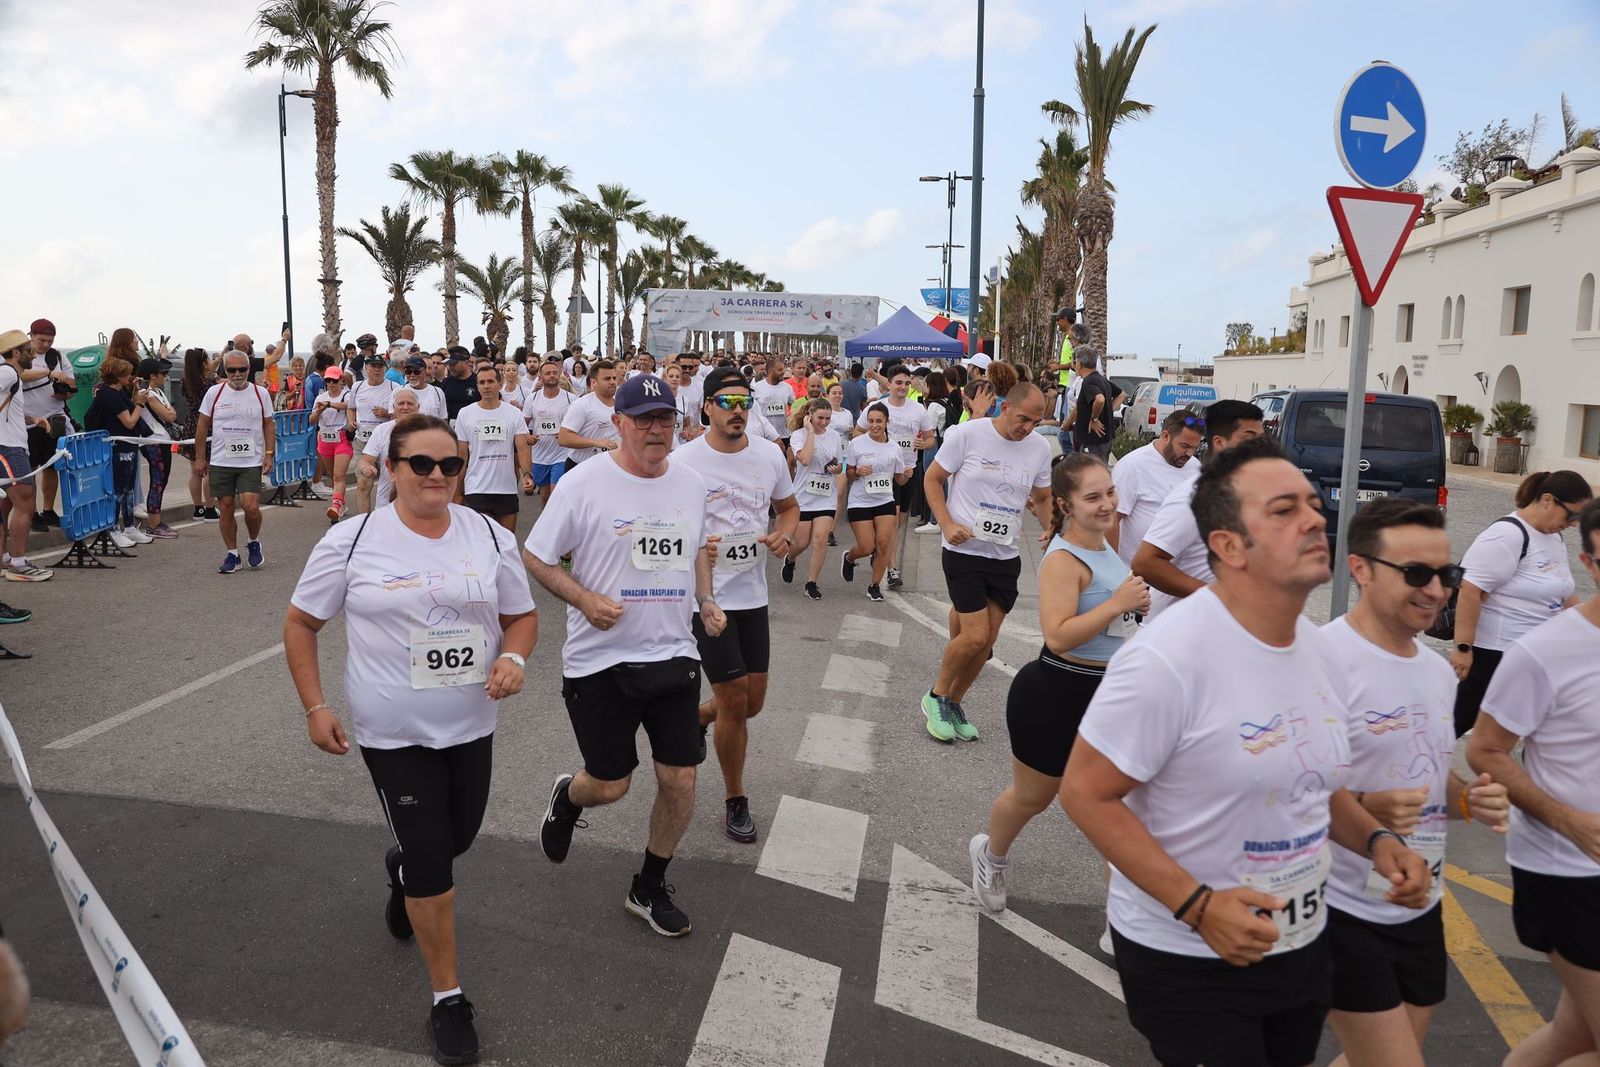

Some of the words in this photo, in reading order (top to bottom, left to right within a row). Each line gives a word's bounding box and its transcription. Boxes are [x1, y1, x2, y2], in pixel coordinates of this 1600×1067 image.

[720, 297, 734, 306] 3A
[737, 298, 787, 308] CARRERA
[790, 300, 804, 309] 5K
[868, 344, 941, 352] info@dorsalchip.es
[362, 430, 373, 438] 29
[484, 426, 501, 434] 371
[230, 443, 250, 452] 392
[810, 480, 830, 490] 1145
[867, 479, 889, 488] 1106
[983, 520, 1009, 535] 923
[638, 536, 683, 556] 1261
[725, 542, 758, 560] 431
[620, 588, 648, 596] DONACIÓN
[426, 646, 475, 670] 962
